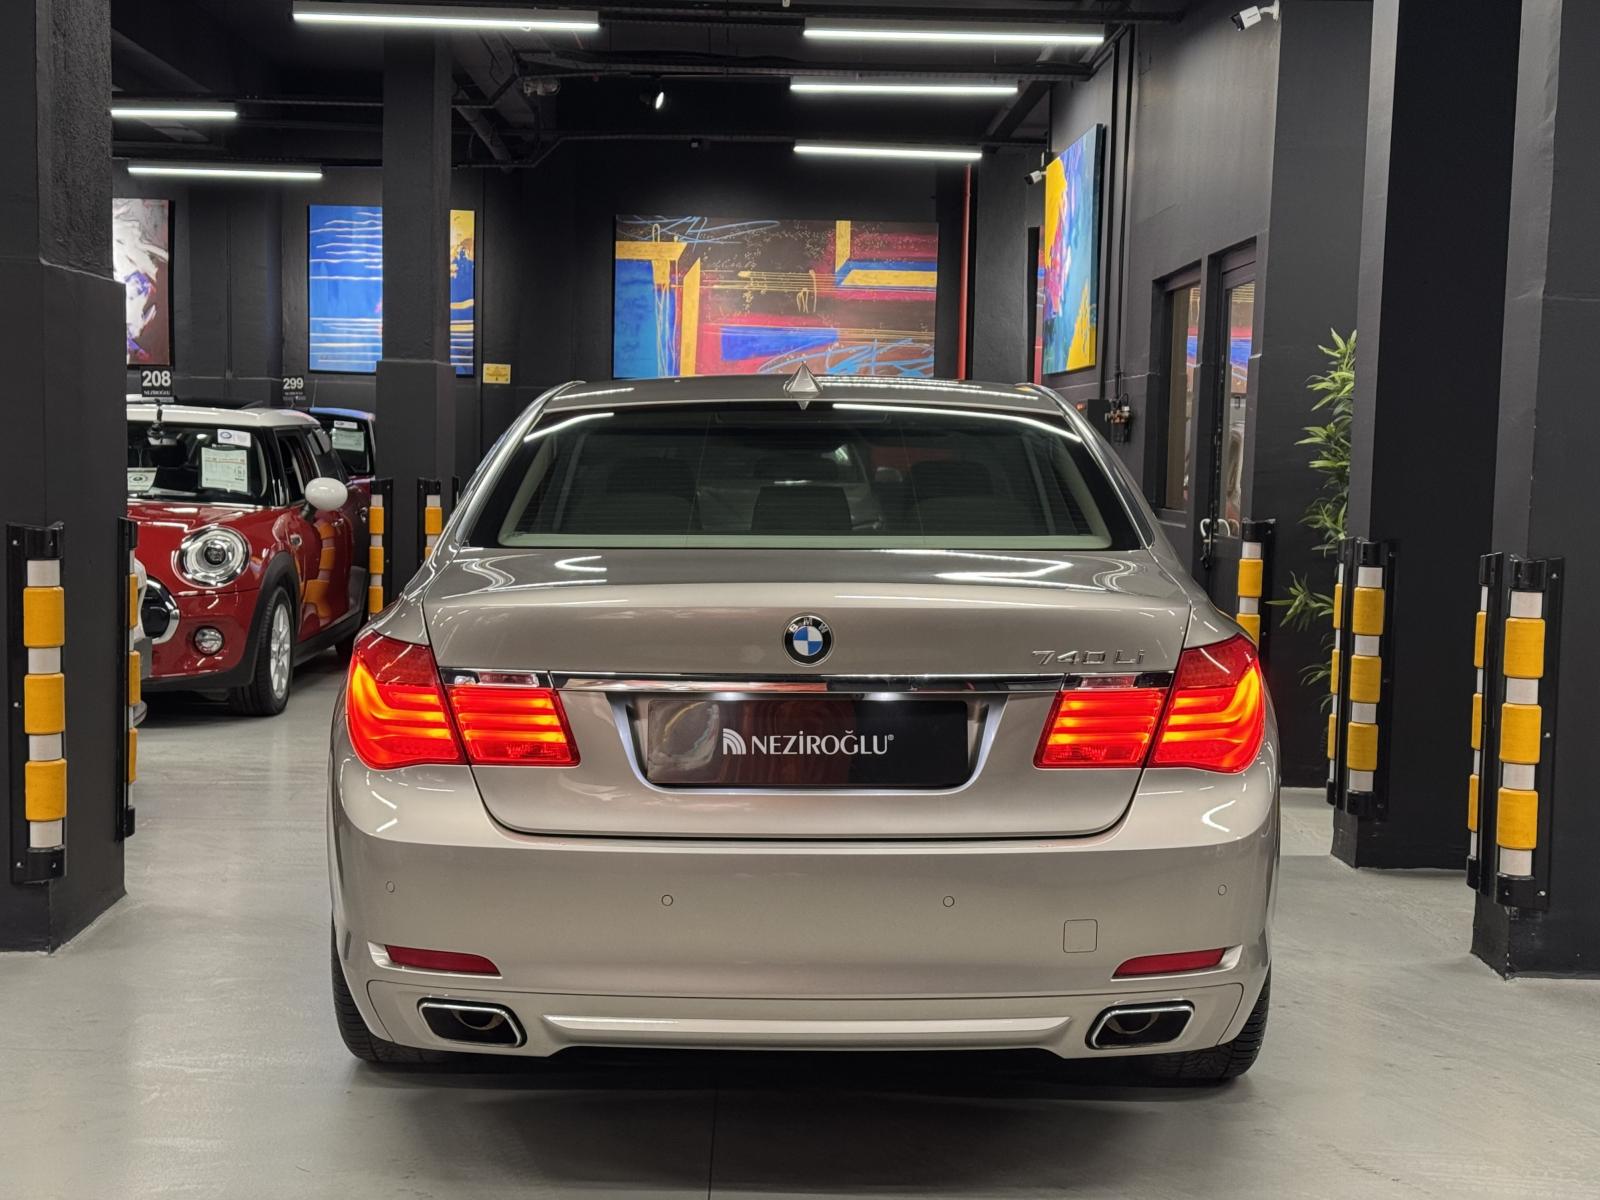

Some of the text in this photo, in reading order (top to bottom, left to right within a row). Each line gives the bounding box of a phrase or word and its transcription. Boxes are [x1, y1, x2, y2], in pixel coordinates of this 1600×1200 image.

[142, 370, 171, 387] 208
[283, 377, 304, 390] 299
[789, 617, 829, 633] BMW
